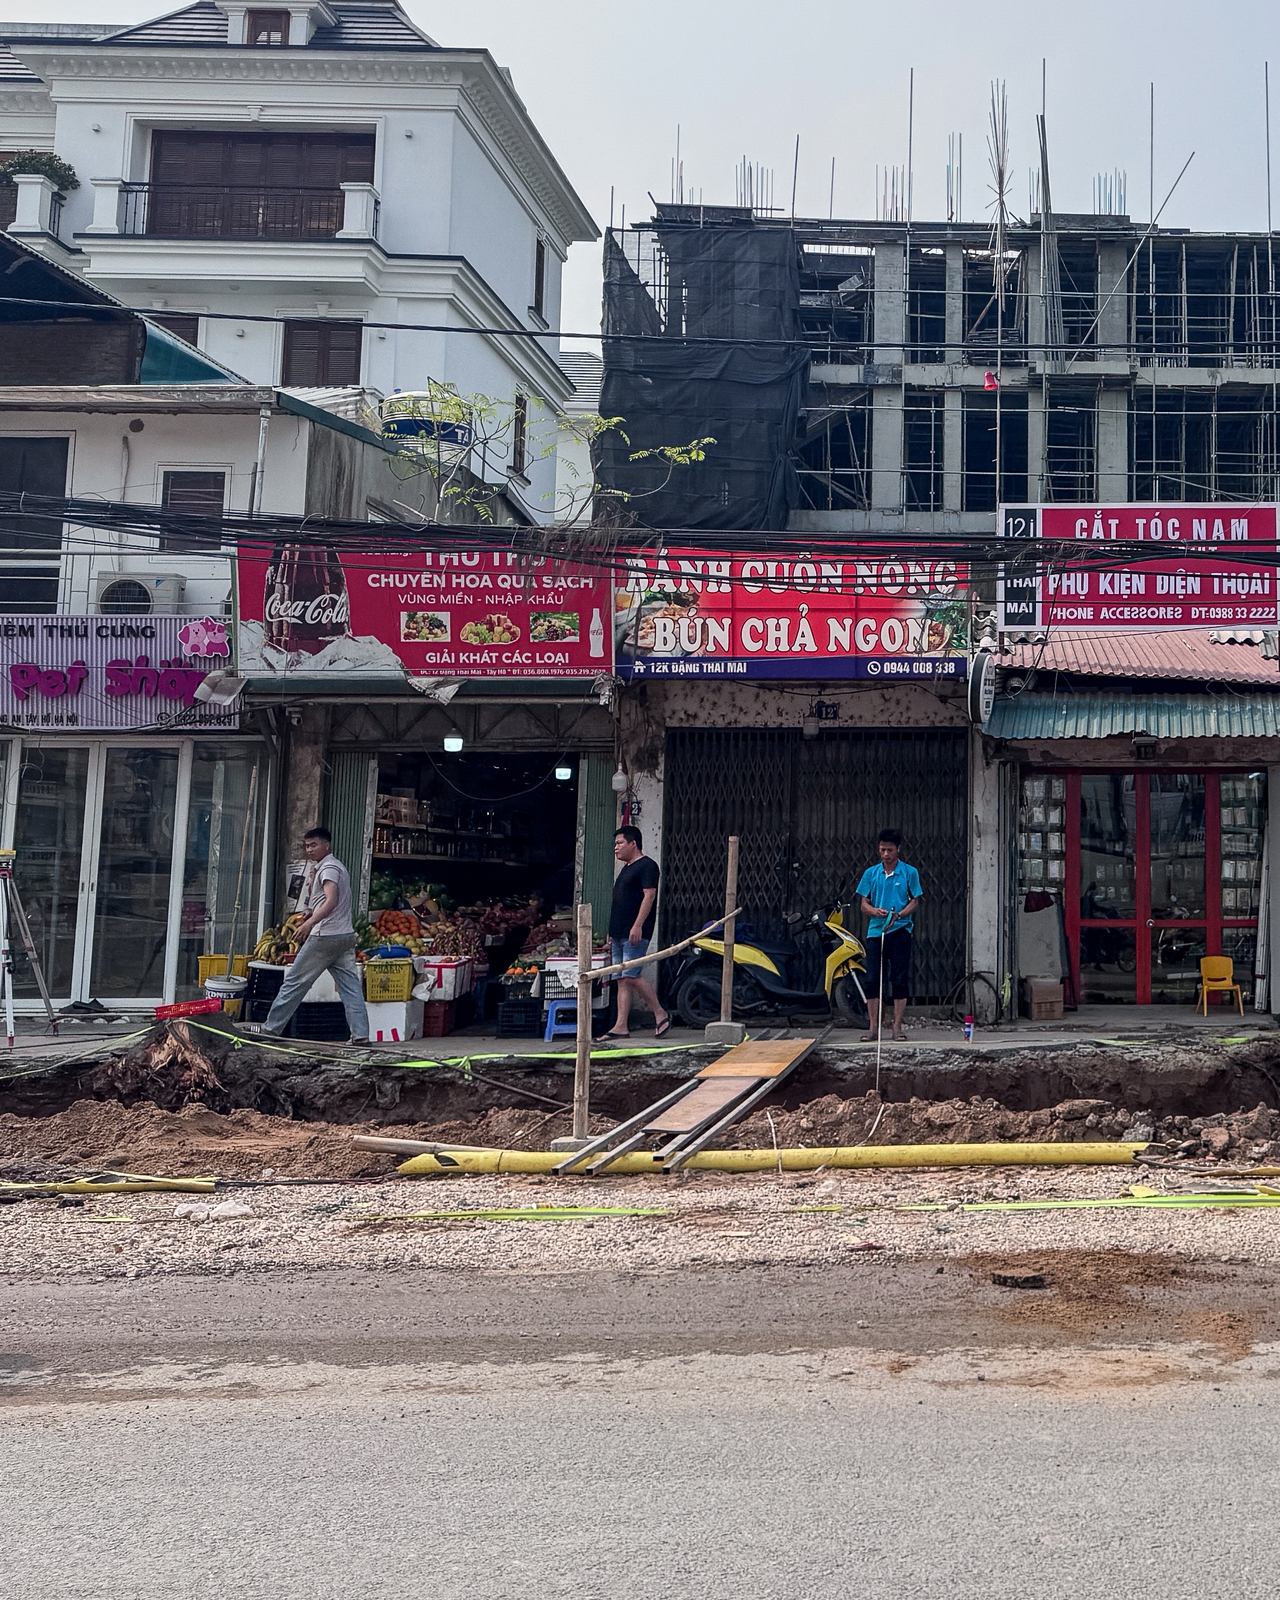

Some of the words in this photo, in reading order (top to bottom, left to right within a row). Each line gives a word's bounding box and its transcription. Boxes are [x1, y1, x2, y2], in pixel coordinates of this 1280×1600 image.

[1075, 511, 1119, 539] CẮT
[1136, 512, 1180, 540] TÓC
[1193, 519, 1248, 540] NAM
[625, 548, 732, 593] BÁNH
[1048, 573, 1089, 599] PHỤ
[1099, 568, 1146, 599] KIỆN
[1156, 568, 1201, 599] ĐIỆN
[398, 592, 436, 605] VÙNG
[441, 590, 473, 605] MIỀN
[485, 592, 523, 606] NHẬP
[265, 593, 349, 624] Coca-Cola
[1006, 602, 1033, 614] MAI
[1050, 608, 1094, 620] PHONE
[1235, 607, 1247, 619] 33
[1249, 607, 1276, 619] 2222
[43, 620, 88, 638] THÚ
[96, 621, 156, 638] CƯNG
[652, 607, 733, 652] BÚN
[741, 603, 818, 652] CHẢ
[827, 618, 931, 652] NGON
[425, 649, 455, 664] GIẢI
[459, 651, 498, 663] KHÁT
[502, 651, 532, 663] CÁC
[536, 653, 569, 666] LOẠI
[651, 662, 669, 673] 12K
[671, 661, 699, 676] ĐẶNG
[702, 662, 724, 673] THAI
[727, 662, 747, 673] MAI
[883, 662, 910, 674] 0944
[912, 662, 933, 674] 008
[9, 659, 87, 701] Pet
